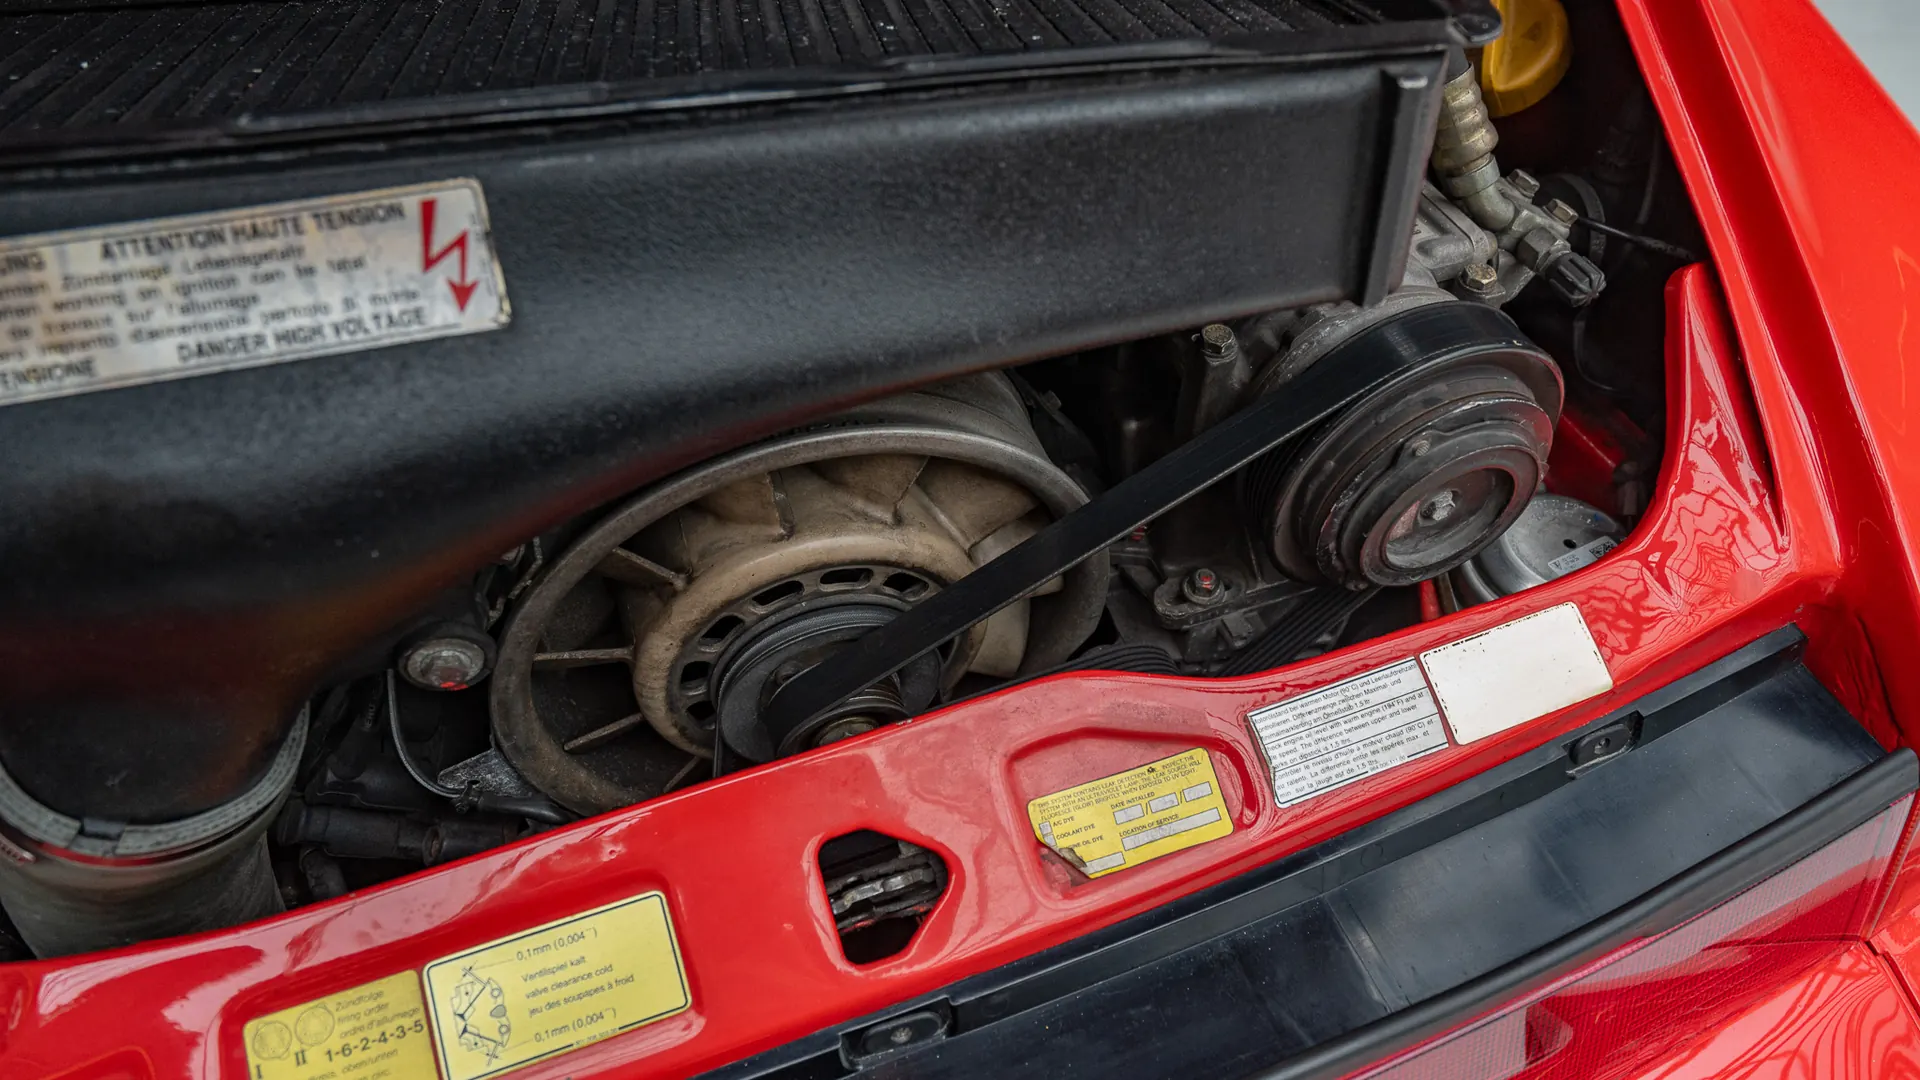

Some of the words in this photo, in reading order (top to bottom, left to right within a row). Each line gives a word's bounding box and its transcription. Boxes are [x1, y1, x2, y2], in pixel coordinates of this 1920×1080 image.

[97, 225, 227, 261] ATTENTION
[229, 215, 305, 243] HAUTE
[311, 201, 406, 232] TENSION
[175, 329, 269, 363] DANGER
[272, 320, 325, 347] HIGH
[328, 304, 427, 338] VOLTAGE
[1288, 703, 1299, 712] bei
[1299, 695, 1322, 708] warmen
[1322, 690, 1339, 700] Motor
[1358, 679, 1370, 687] und
[1370, 662, 1417, 683] Leerlaufdrehzahl
[1389, 678, 1402, 687] und
[1266, 741, 1281, 751] heck
[1282, 734, 1304, 747] engine
[1313, 725, 1328, 735] level
[1328, 720, 1342, 730] with
[1342, 715, 1359, 725] warm
[1359, 707, 1381, 719] engine
[1404, 694, 1416, 702] and
[1300, 740, 1312, 750] The
[1313, 730, 1342, 745] difference
[1344, 720, 1369, 734] between
[1370, 715, 1387, 725] upper
[1388, 709, 1400, 718] and
[1400, 703, 1417, 713] lower
[1037, 800, 1049, 809] THIS
[1050, 793, 1072, 804] SYSTEM
[1072, 784, 1101, 798] CONTAINS
[1101, 780, 1115, 789] LEAK
[1116, 770, 1146, 784] DETECTION
[1161, 758, 1182, 769] INSPECT
[1272, 760, 1286, 769] arks
[1039, 804, 1060, 815] SYSTEM
[1061, 799, 1076, 807] WITH
[1086, 784, 1123, 800] ULTRAVIOLET
[1152, 770, 1166, 779] LEAK
[1167, 764, 1187, 774] SOURCE
[1188, 759, 1201, 767] WILL
[1040, 807, 1071, 821] FLUORESCE
[1072, 800, 1093, 811] (GLOW)
[1094, 791, 1120, 804] BRIGHTLY
[1121, 786, 1138, 795] WHEN
[1138, 778, 1162, 790] EXPOSED
[1110, 800, 1125, 809] DATE
[1125, 791, 1155, 804] INSTALLED
[1056, 827, 1083, 840] COOLANT
[1083, 823, 1095, 831] DYE
[1063, 815, 1075, 823] DYE
[1091, 834, 1103, 842] DYE
[1119, 823, 1147, 837] LOCATION
[1156, 813, 1179, 825] SERVICE
[521, 960, 568, 985] Ventilspiel
[569, 954, 586, 967] kalt
[524, 984, 549, 1000] valve
[550, 970, 592, 991] clearance
[594, 963, 613, 977] cold
[336, 1010, 361, 1025] firing
[363, 1001, 389, 1016] order
[527, 1003, 543, 1018] jeu
[544, 997, 561, 1011] des
[562, 984, 605, 1006] soupapes
[606, 980, 614, 991] à
[614, 973, 635, 988] froid
[324, 1018, 424, 1062] 1-6-2-4-3-5
